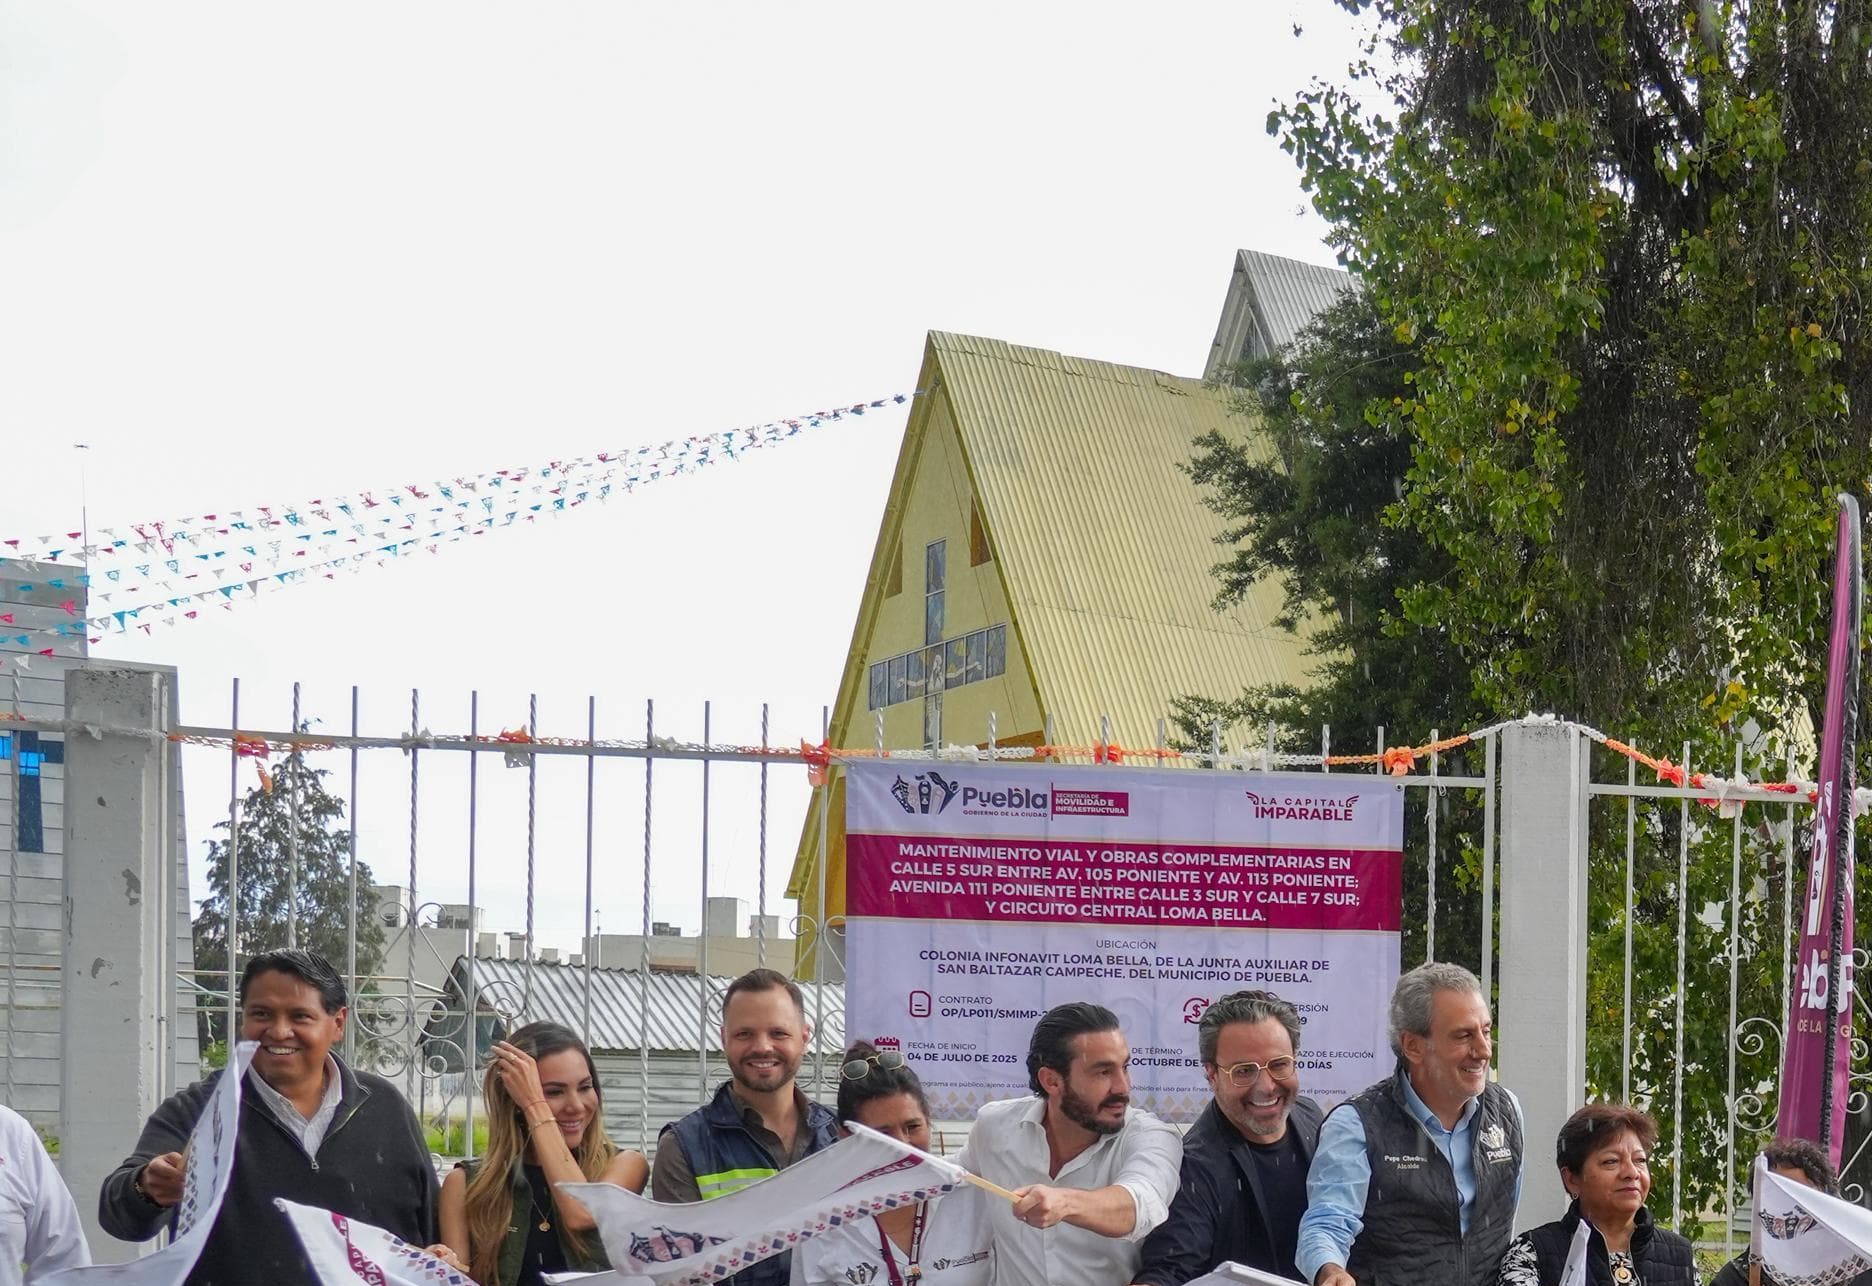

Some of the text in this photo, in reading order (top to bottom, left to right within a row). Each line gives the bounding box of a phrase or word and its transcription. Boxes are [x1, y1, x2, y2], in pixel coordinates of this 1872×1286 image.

[963, 787, 1048, 809] Puebla
[1056, 798, 1107, 806] MOVILIDAD
[1262, 797, 1344, 807] LA CAPITAL
[1056, 806, 1126, 814] INFRAESTRUCTURA
[1256, 806, 1352, 820] IMPARABLE
[899, 844, 1351, 870] MANTENIMIENTO VIAL Y OBRAS COMPLEMENTARIAS EN
[891, 862, 1359, 890] CALLE 5 SUR ENTRE AV. 105 PONIENTE Y AV. 113 PONIENTE;
[890, 880, 1360, 907] AVENIDA 111 PONIENTE ENTRE CALLE 3 SUR Y CALLE 7 SUR;
[985, 900, 1266, 922] Y CIRCUITO CENTRAL LOMA BELLA.
[1096, 938, 1156, 949] UBICACIÓN
[920, 950, 1330, 970] COLONIA INFONAVIT LOMA BELLA, DE LA JUNTA AUXILIAR DE
[938, 964, 1312, 983] SAN BALTAZAR CAMPECHE, DEL MUNICIPIO DE PUEBLA.
[938, 996, 992, 1004] CONTRATO
[1295, 1004, 1328, 1012] ERSIÓN
[1810, 1020, 1822, 1034] LA
[938, 1042, 949, 1050] DE
[1145, 1047, 1183, 1055] TÉRMINO
[908, 1052, 1018, 1063] 04 DE JULIO DE 2025
[1132, 1058, 1199, 1067] OCTUBRE DE
[1308, 1060, 1332, 1070] DÍAS
[1486, 1147, 1512, 1161] Puebla
